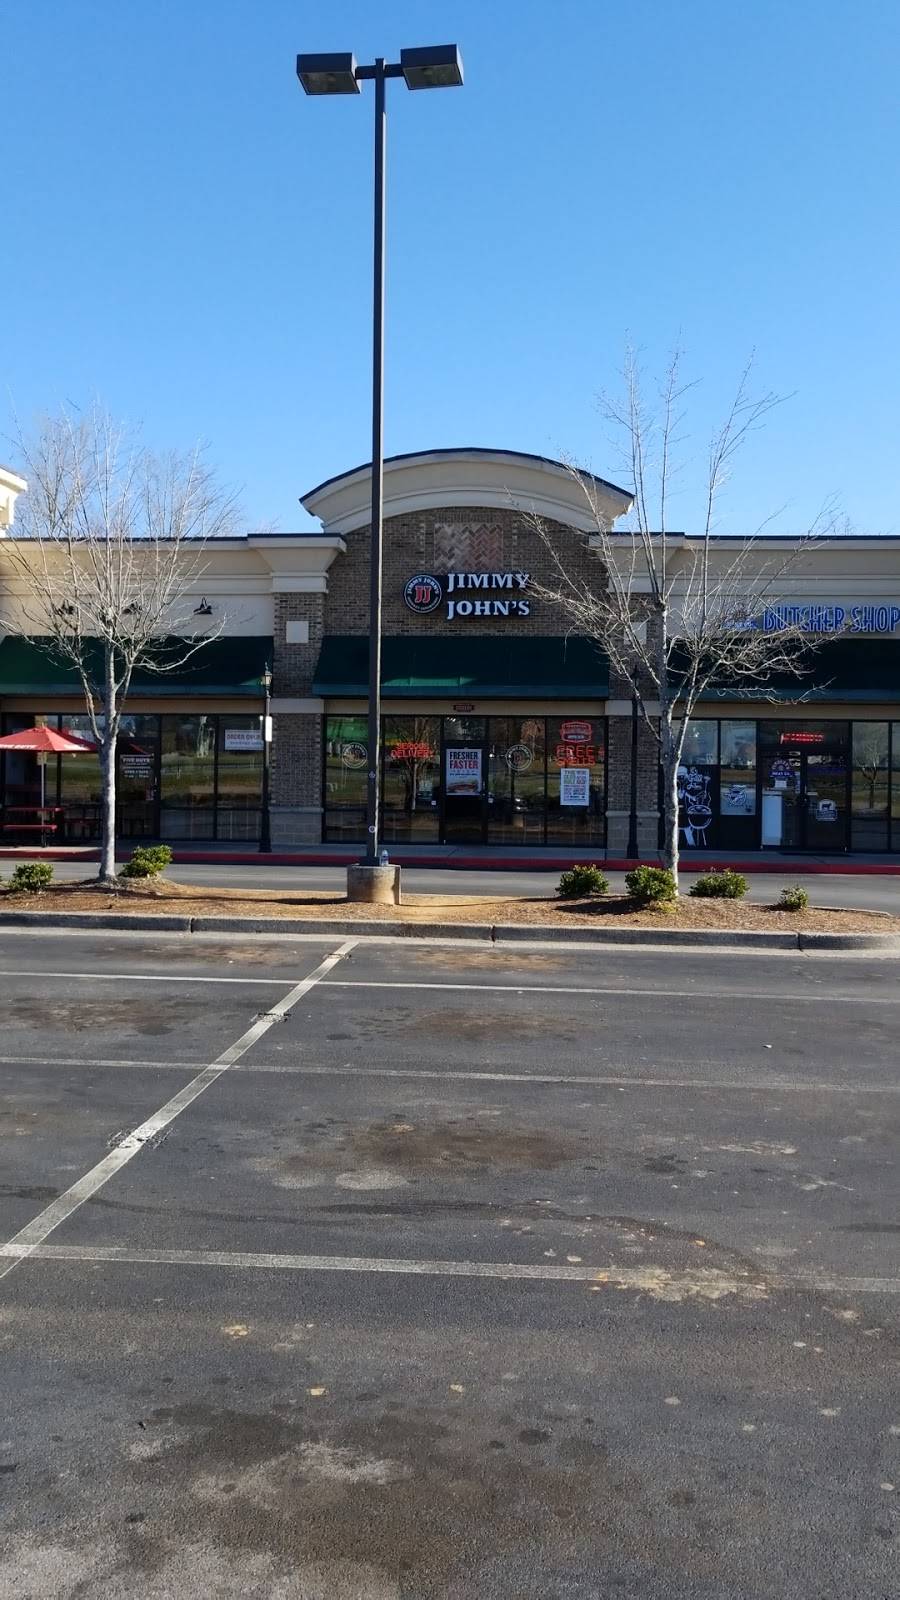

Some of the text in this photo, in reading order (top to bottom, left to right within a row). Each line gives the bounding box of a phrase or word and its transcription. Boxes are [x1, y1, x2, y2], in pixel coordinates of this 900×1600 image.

[447, 573, 529, 592] JIMMY
[446, 600, 530, 620] JOHN'S
[763, 605, 846, 632] BUTCHER
[850, 605, 900, 632] SHOP
[449, 751, 479, 760] FRESHER
[556, 745, 595, 758] FREE
[449, 760, 479, 769] FASTER
